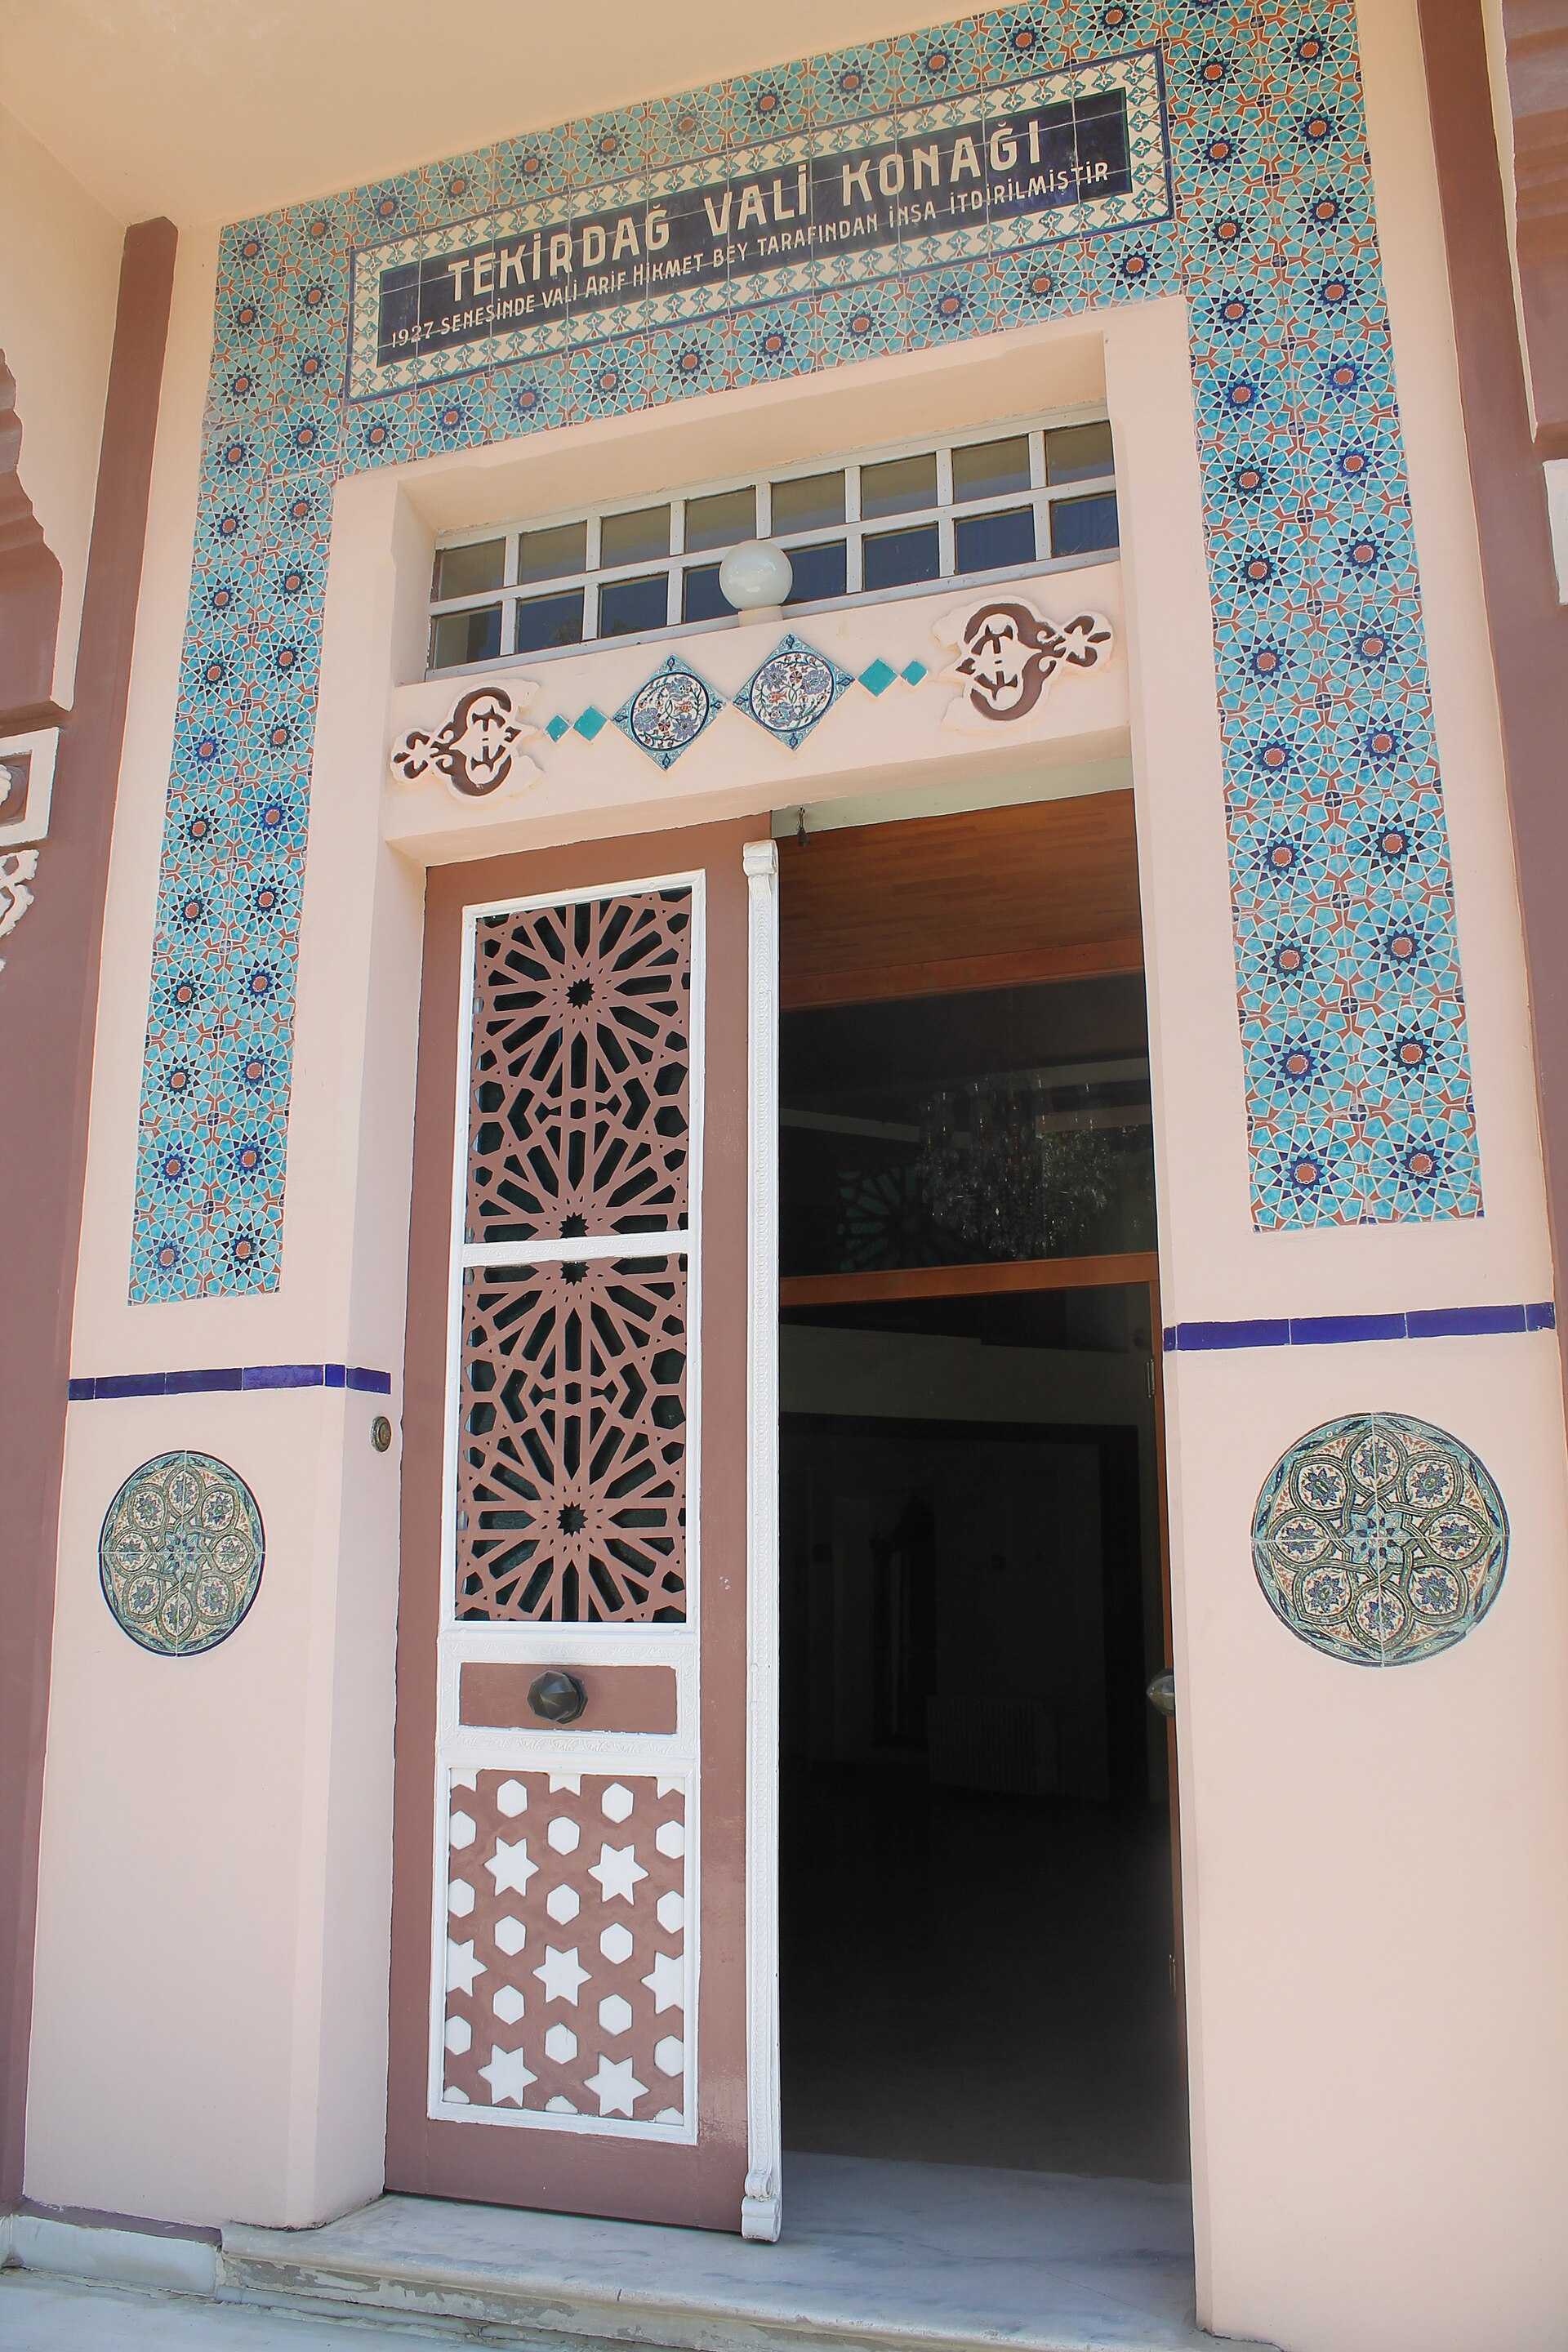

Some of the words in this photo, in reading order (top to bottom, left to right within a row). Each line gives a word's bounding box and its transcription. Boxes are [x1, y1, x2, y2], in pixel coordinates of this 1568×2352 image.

[391, 320, 434, 348] 1927
[440, 294, 535, 335] SENESİNDE
[541, 279, 577, 309] VALİ
[585, 270, 626, 298] ARİF
[633, 253, 704, 287] HİKMET
[713, 243, 748, 268] BEY
[757, 213, 878, 256] TARAFINDAN
[889, 201, 937, 229] İNŞA
[950, 161, 1109, 215] İTDİRİLMİŞTİR
[448, 203, 670, 302] TEKİRDAĞ
[702, 163, 808, 237] VALİ
[840, 120, 1043, 207] KONAĞI
